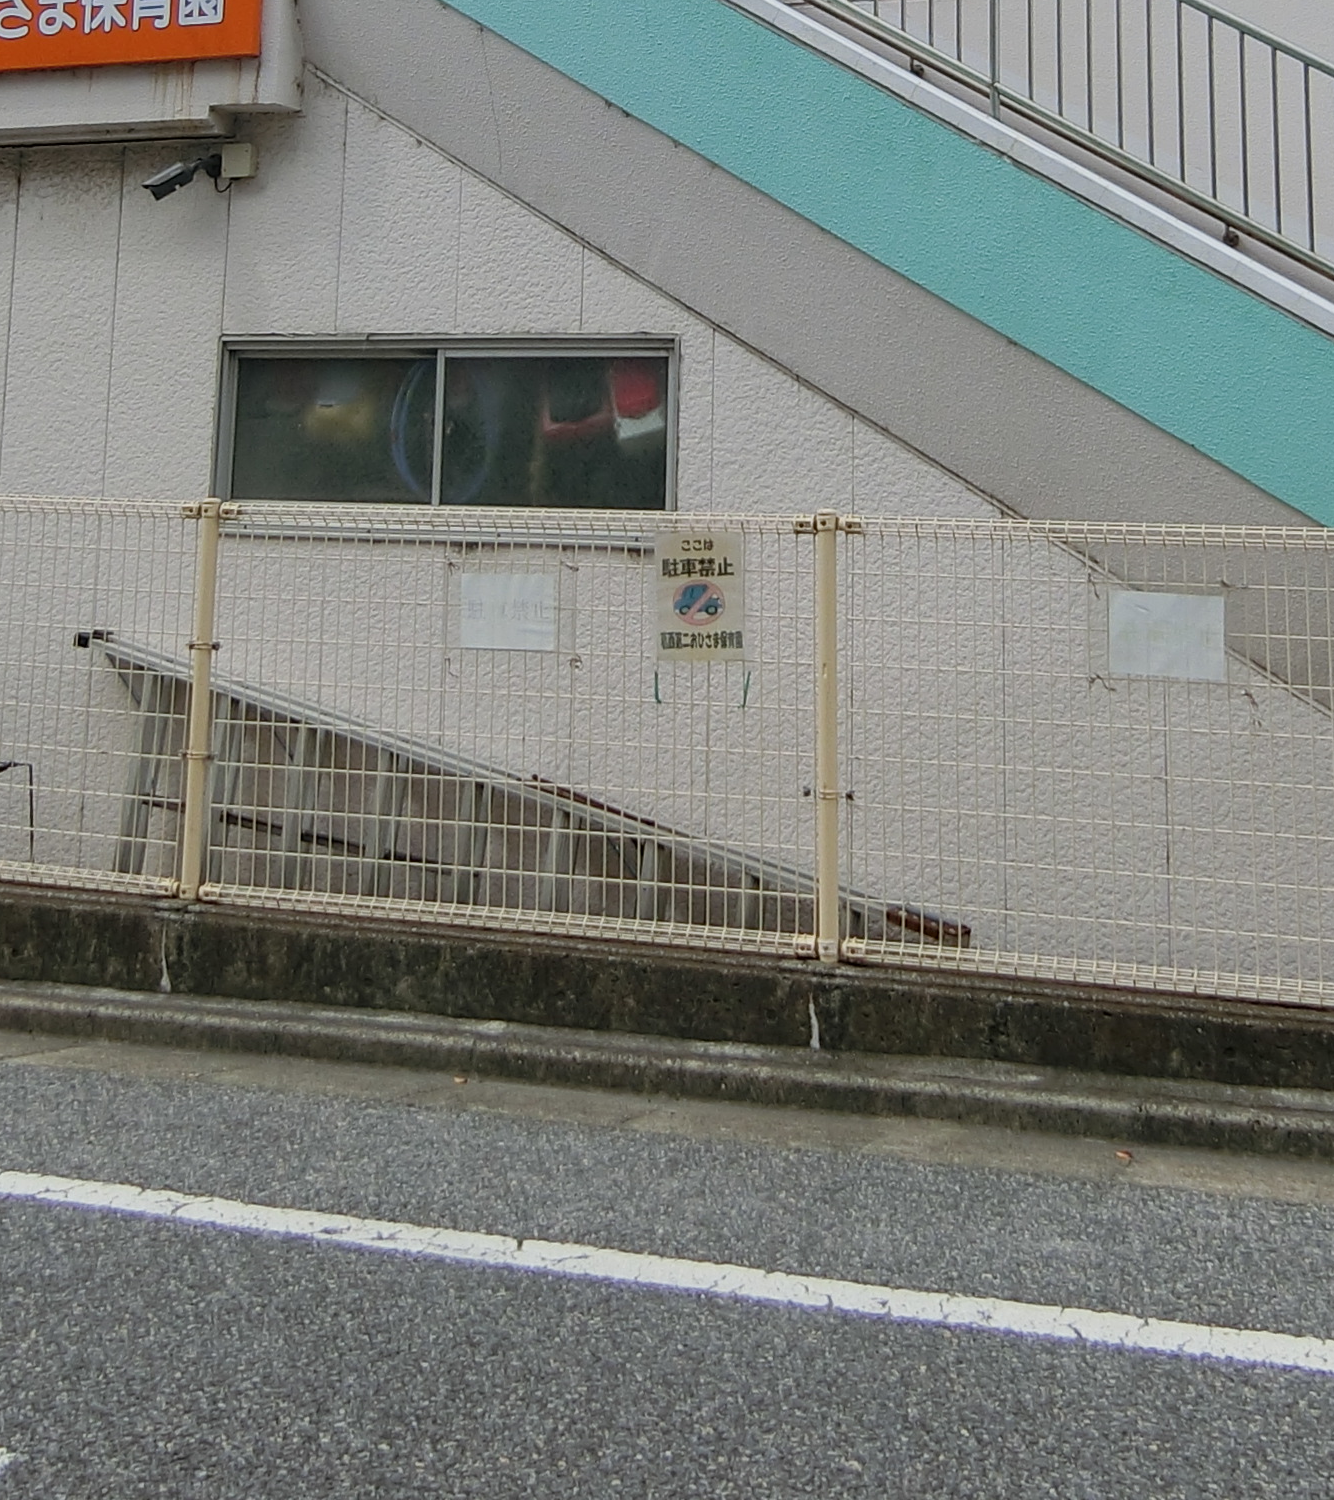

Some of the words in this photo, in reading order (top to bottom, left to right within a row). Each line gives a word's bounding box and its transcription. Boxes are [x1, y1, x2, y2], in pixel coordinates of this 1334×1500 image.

[680, 539, 713, 552] ここは
[661, 556, 735, 578] 駐車禁止
